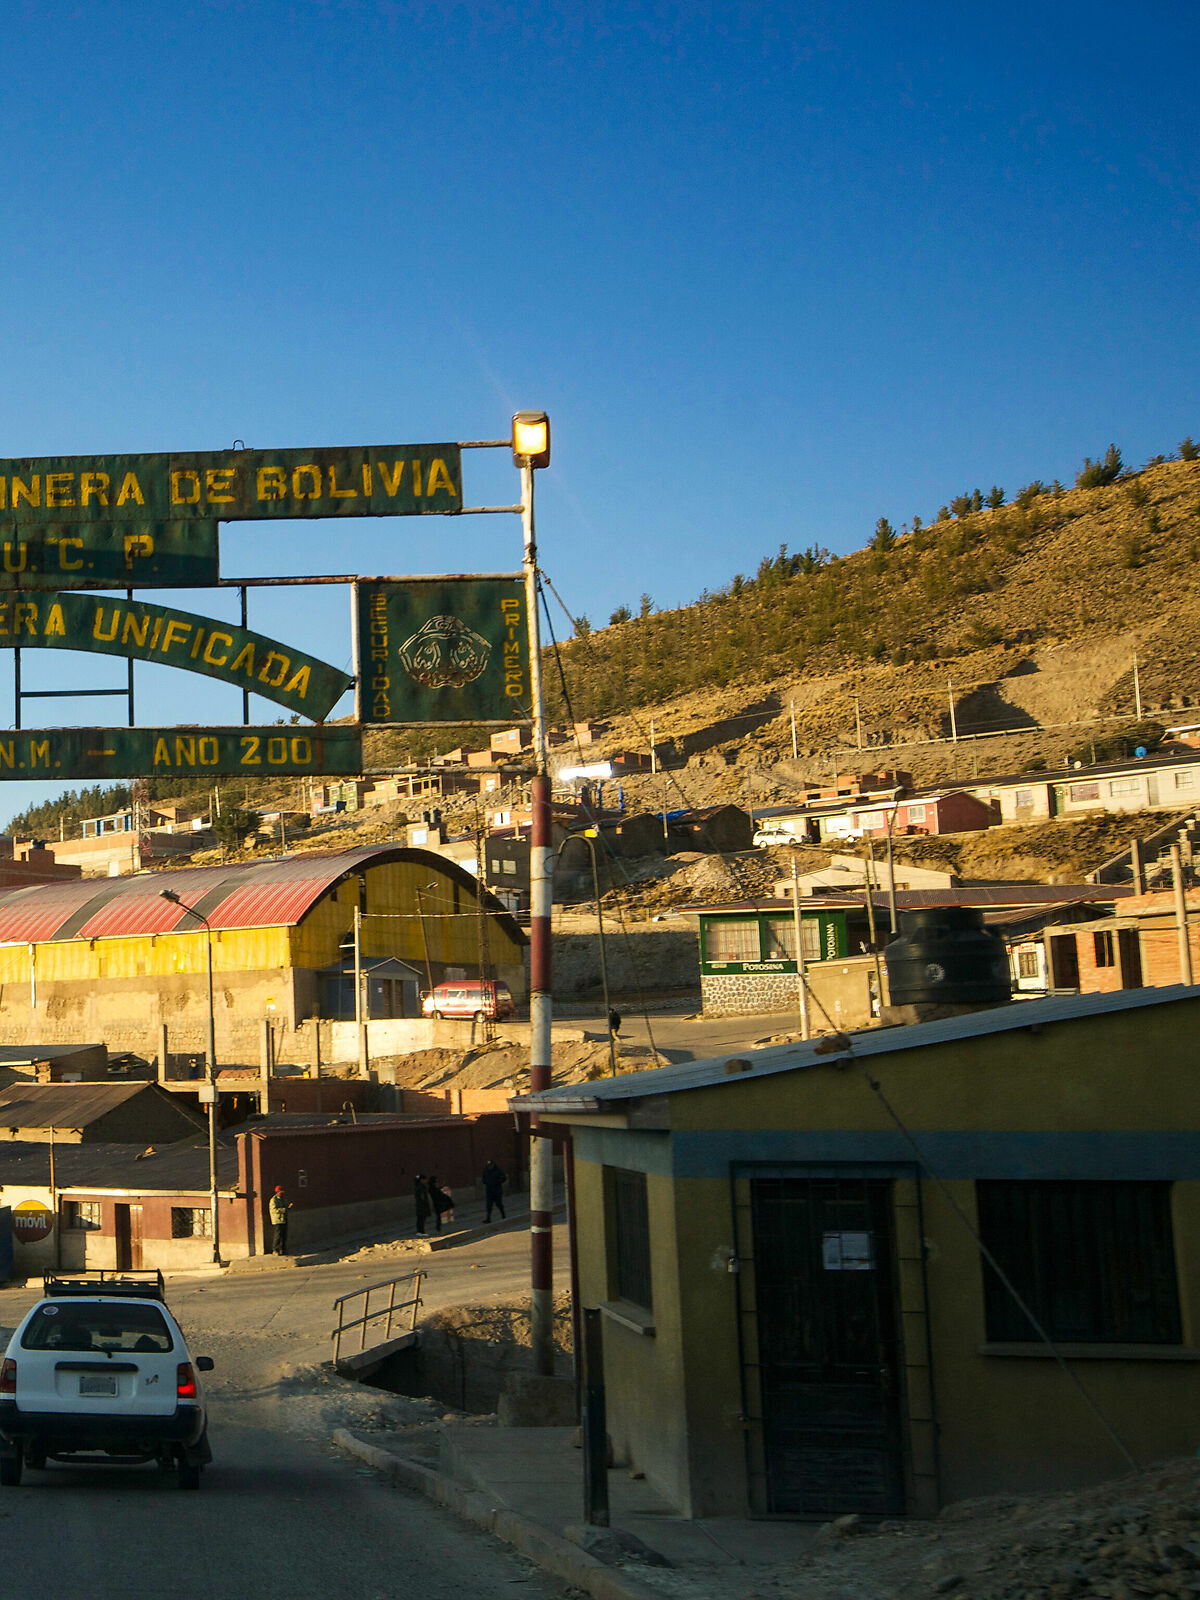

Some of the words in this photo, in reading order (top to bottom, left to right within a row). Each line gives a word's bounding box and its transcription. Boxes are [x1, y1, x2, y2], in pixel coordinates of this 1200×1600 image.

[172, 468, 237, 505] DE
[256, 458, 458, 501] BOLIVIA
[93, 607, 313, 699] UNIFICADA
[370, 593, 391, 718] SEGURIDAD
[501, 599, 524, 697] PRIMERO
[240, 734, 313, 766] 200
[15, 1213, 48, 1231] móvil
